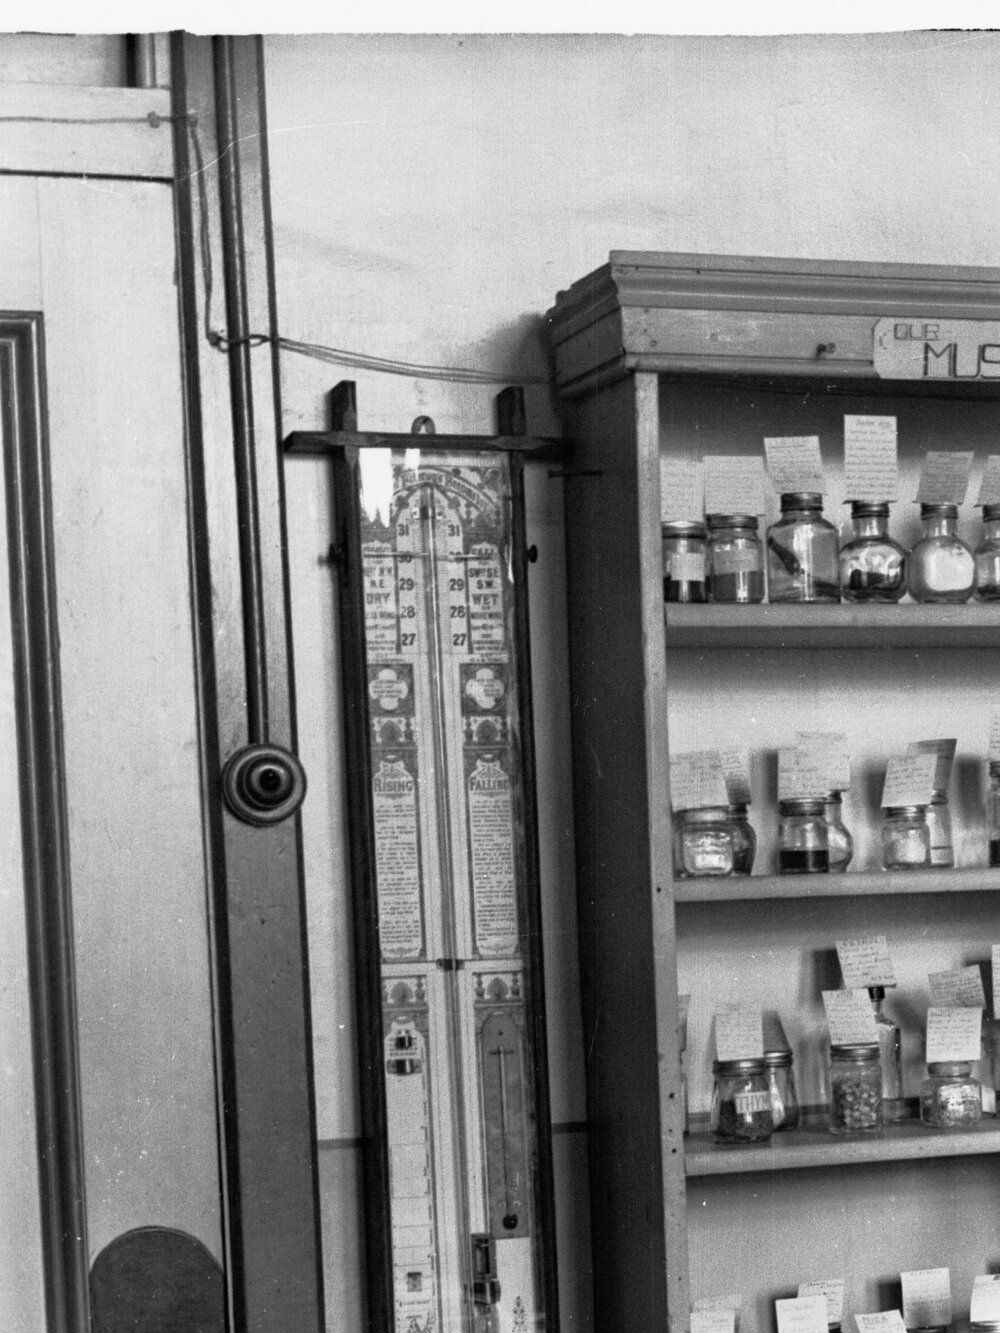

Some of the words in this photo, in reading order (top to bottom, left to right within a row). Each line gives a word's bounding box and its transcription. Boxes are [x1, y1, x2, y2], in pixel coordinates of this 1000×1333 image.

[893, 323, 941, 341] OUR
[398, 524, 410, 537] 31
[448, 524, 460, 537] 31
[399, 577, 414, 591] 29
[449, 578, 464, 591] 29
[366, 592, 391, 604] DRY
[472, 593, 499, 605] WET
[400, 605, 416, 619] 28
[450, 605, 466, 619] 28
[401, 633, 416, 646] 27
[452, 633, 466, 647] 27
